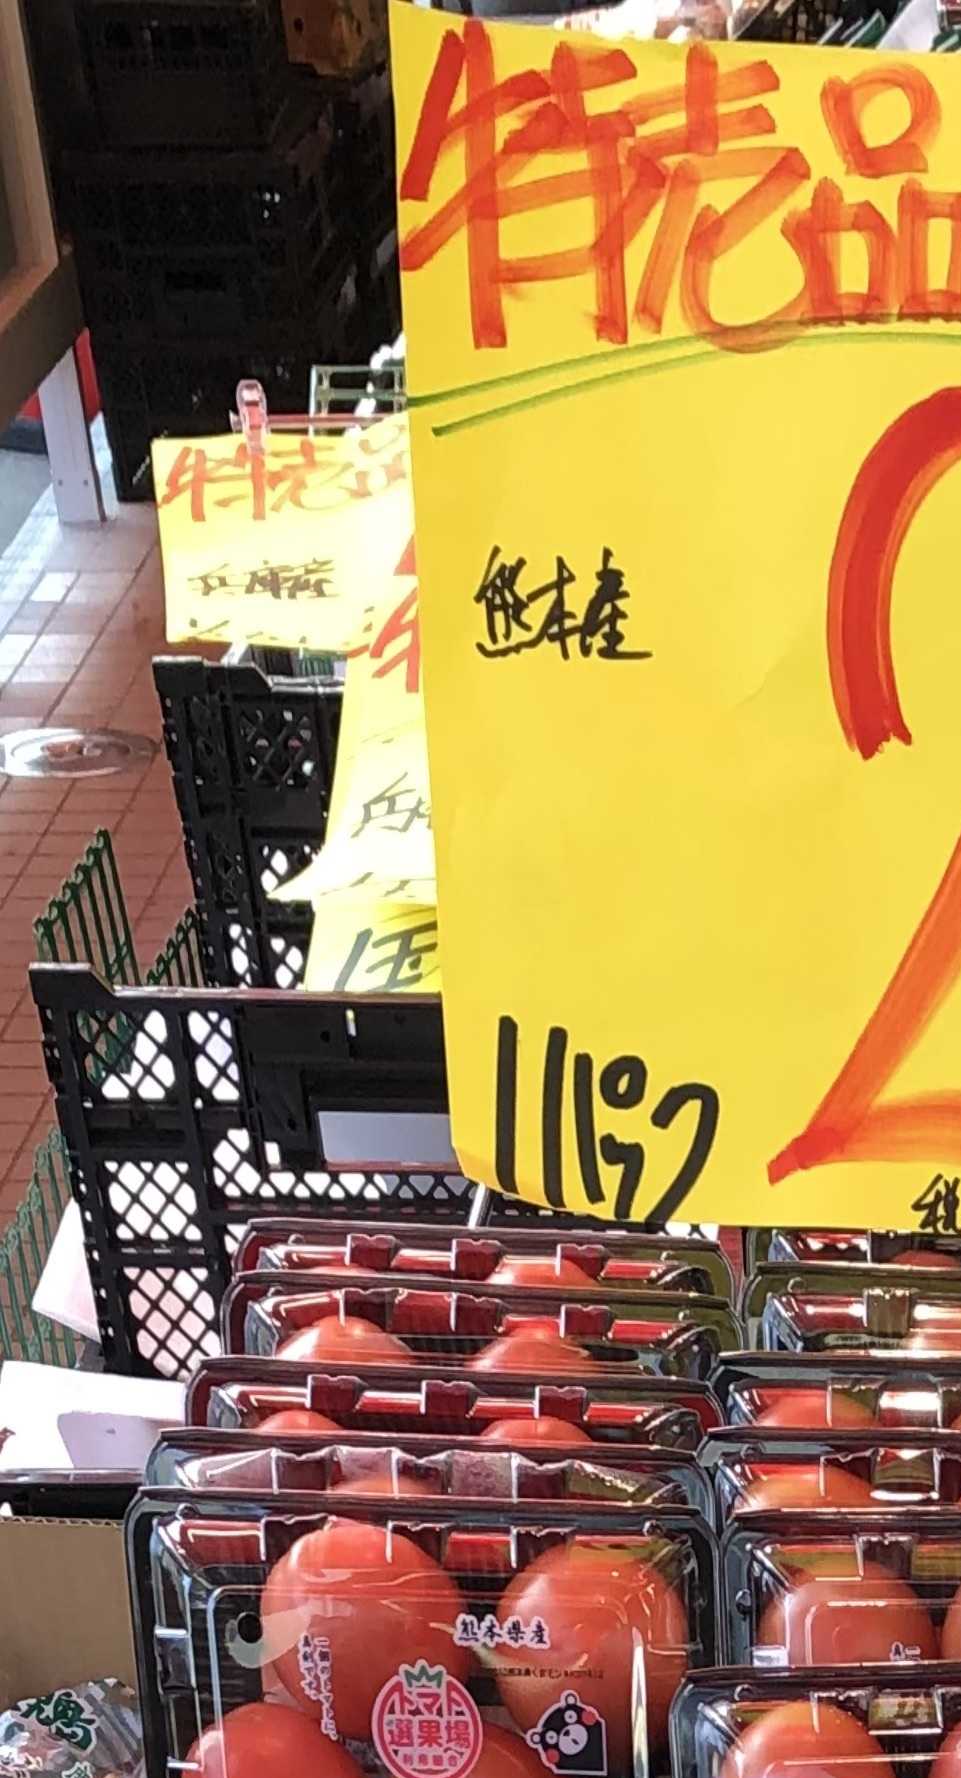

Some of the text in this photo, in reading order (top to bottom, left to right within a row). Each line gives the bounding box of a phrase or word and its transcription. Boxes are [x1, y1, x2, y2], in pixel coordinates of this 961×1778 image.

[475, 545, 653, 661] 熊本産
[459, 1617, 548, 1645] 熊本県産
[393, 1690, 464, 1715] トマト
[388, 1719, 471, 1749] 選果場
